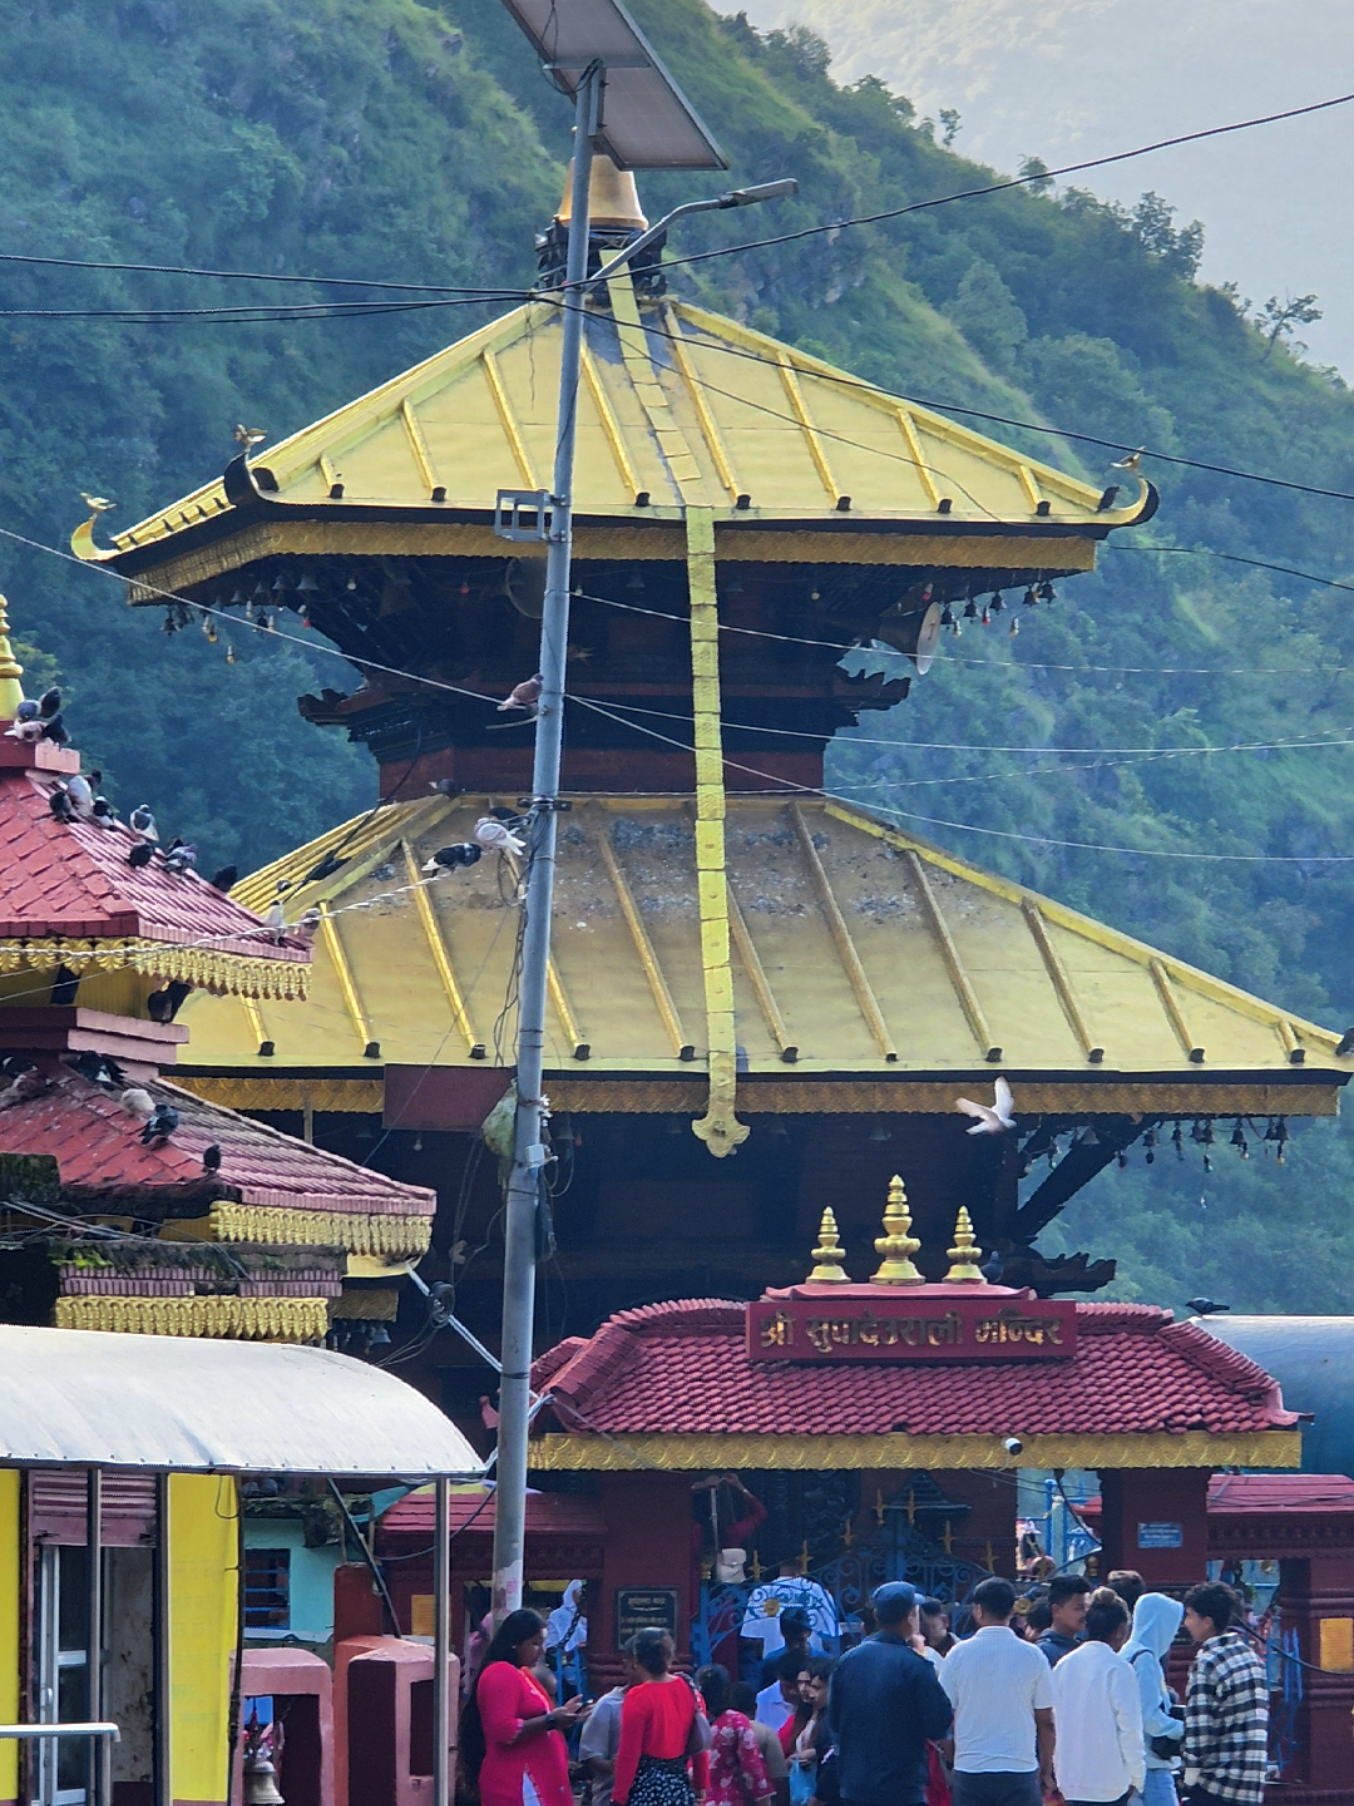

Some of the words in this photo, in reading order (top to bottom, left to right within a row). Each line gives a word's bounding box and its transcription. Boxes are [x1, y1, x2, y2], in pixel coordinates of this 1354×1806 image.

[760, 1308, 795, 1347] श्री
[805, 1308, 963, 1353] सुपादेउराली
[975, 1307, 1063, 1345] मन्दिर
